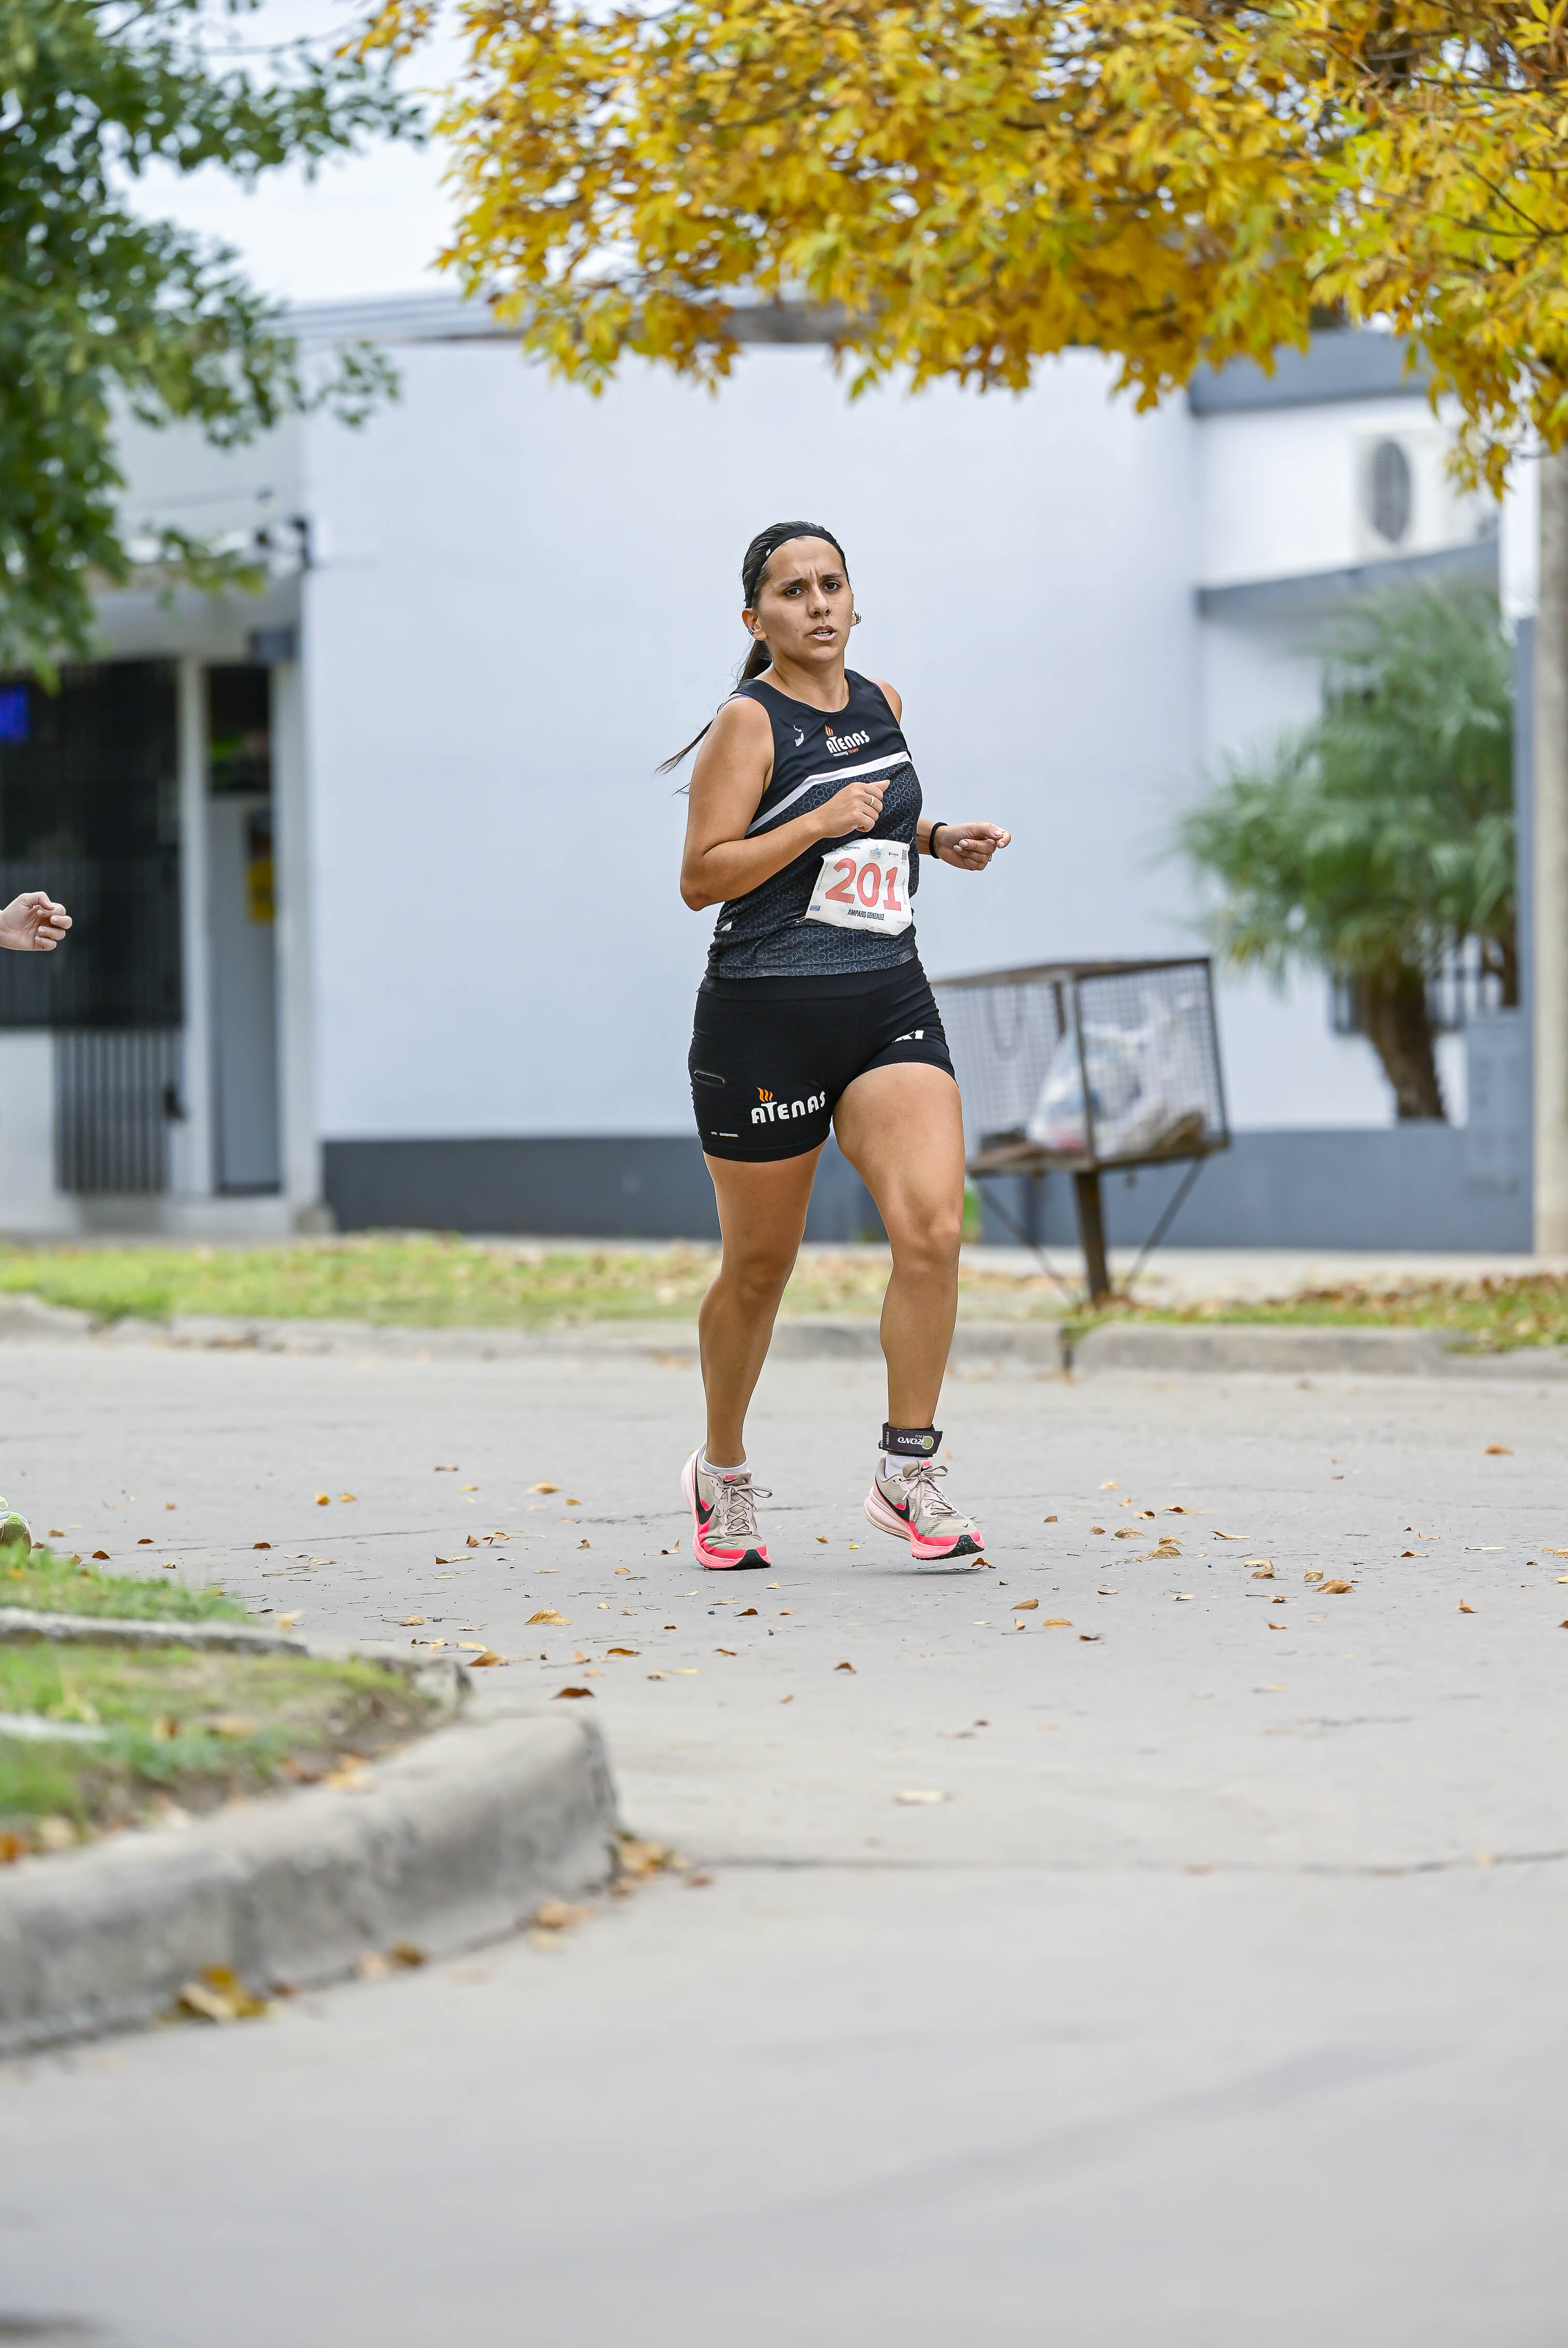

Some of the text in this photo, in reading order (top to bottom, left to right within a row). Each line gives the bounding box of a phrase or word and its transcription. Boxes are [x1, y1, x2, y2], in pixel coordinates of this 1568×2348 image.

[826, 730, 870, 753] ATENAS
[825, 858, 901, 912] 201
[847, 909, 885, 920] AMPARO GONZALEZ
[751, 1091, 826, 1124] ATENAS
